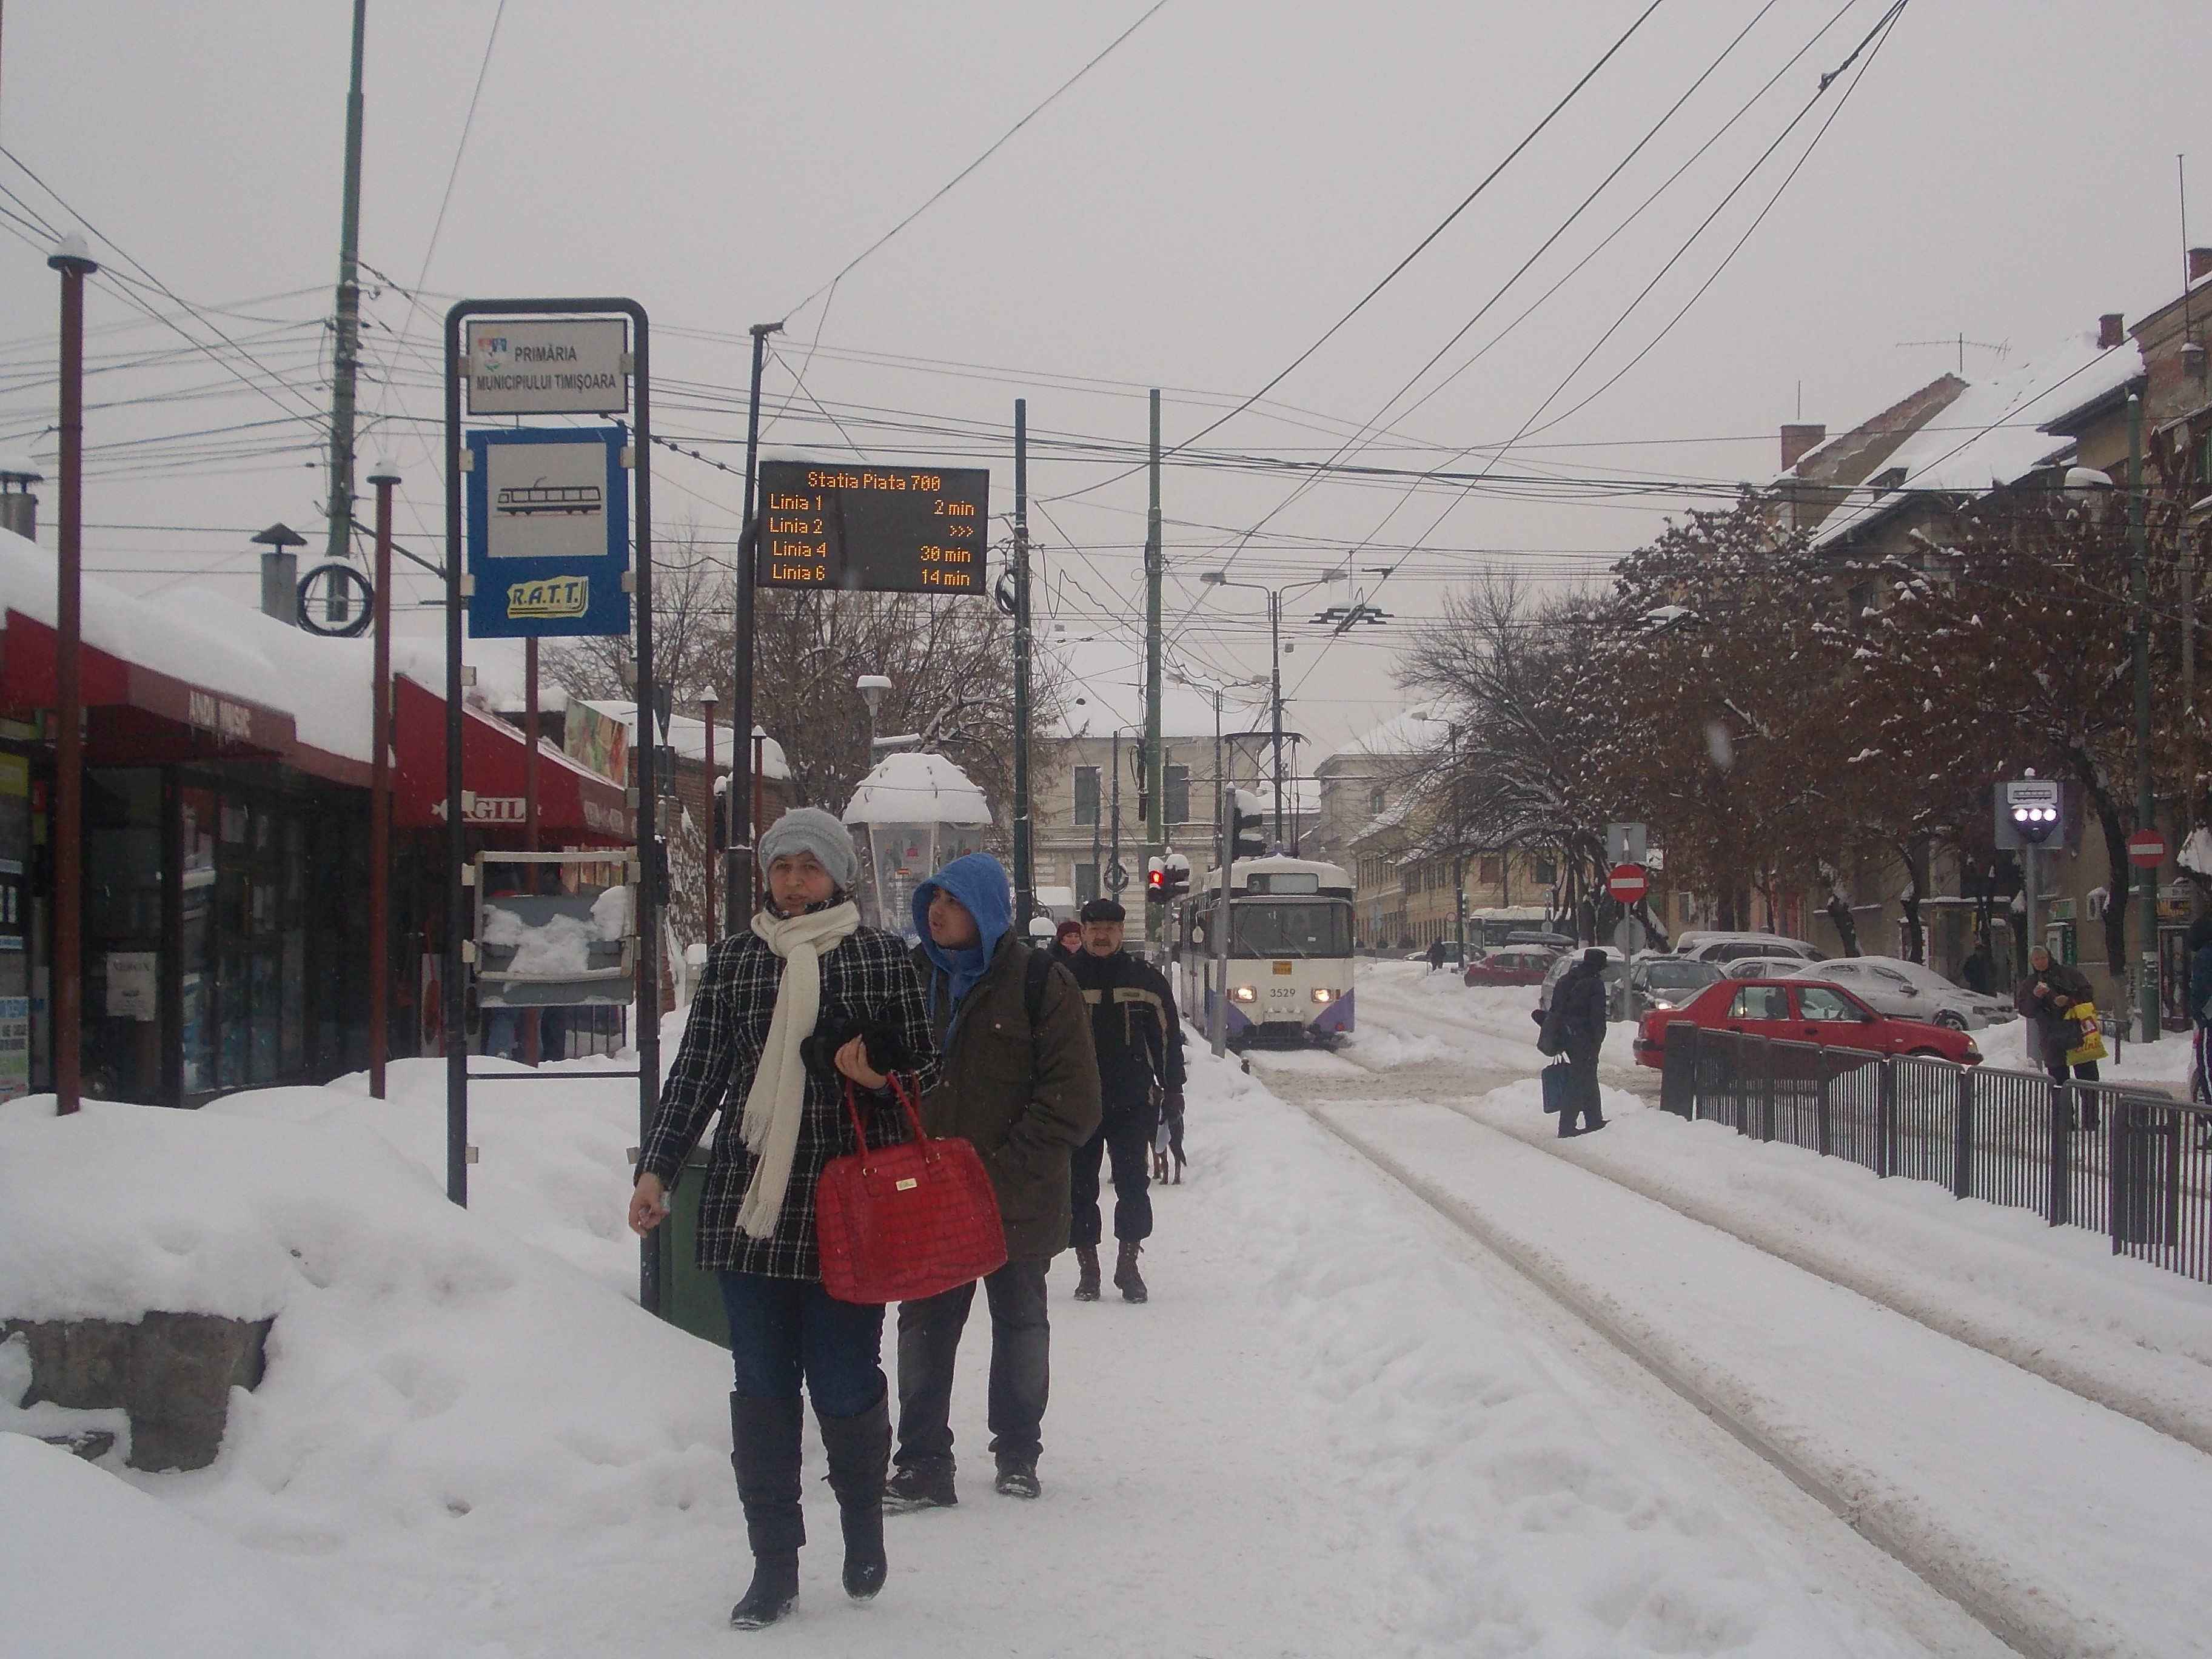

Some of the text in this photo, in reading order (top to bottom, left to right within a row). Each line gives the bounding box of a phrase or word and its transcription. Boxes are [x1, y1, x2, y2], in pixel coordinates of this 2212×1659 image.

[515, 343, 577, 362] PRIMĂRIA
[477, 374, 552, 391] MUNICIPIULUI
[808, 471, 940, 491] Statia Piata 700
[770, 493, 974, 516] Linia 1 2 min
[769, 517, 822, 534] Linia 2
[773, 540, 971, 563] Linia 4 30 min
[773, 563, 970, 586] Linia 6 14 min
[512, 582, 579, 605] R.A.T.T.
[1270, 988, 1296, 998] 3529
